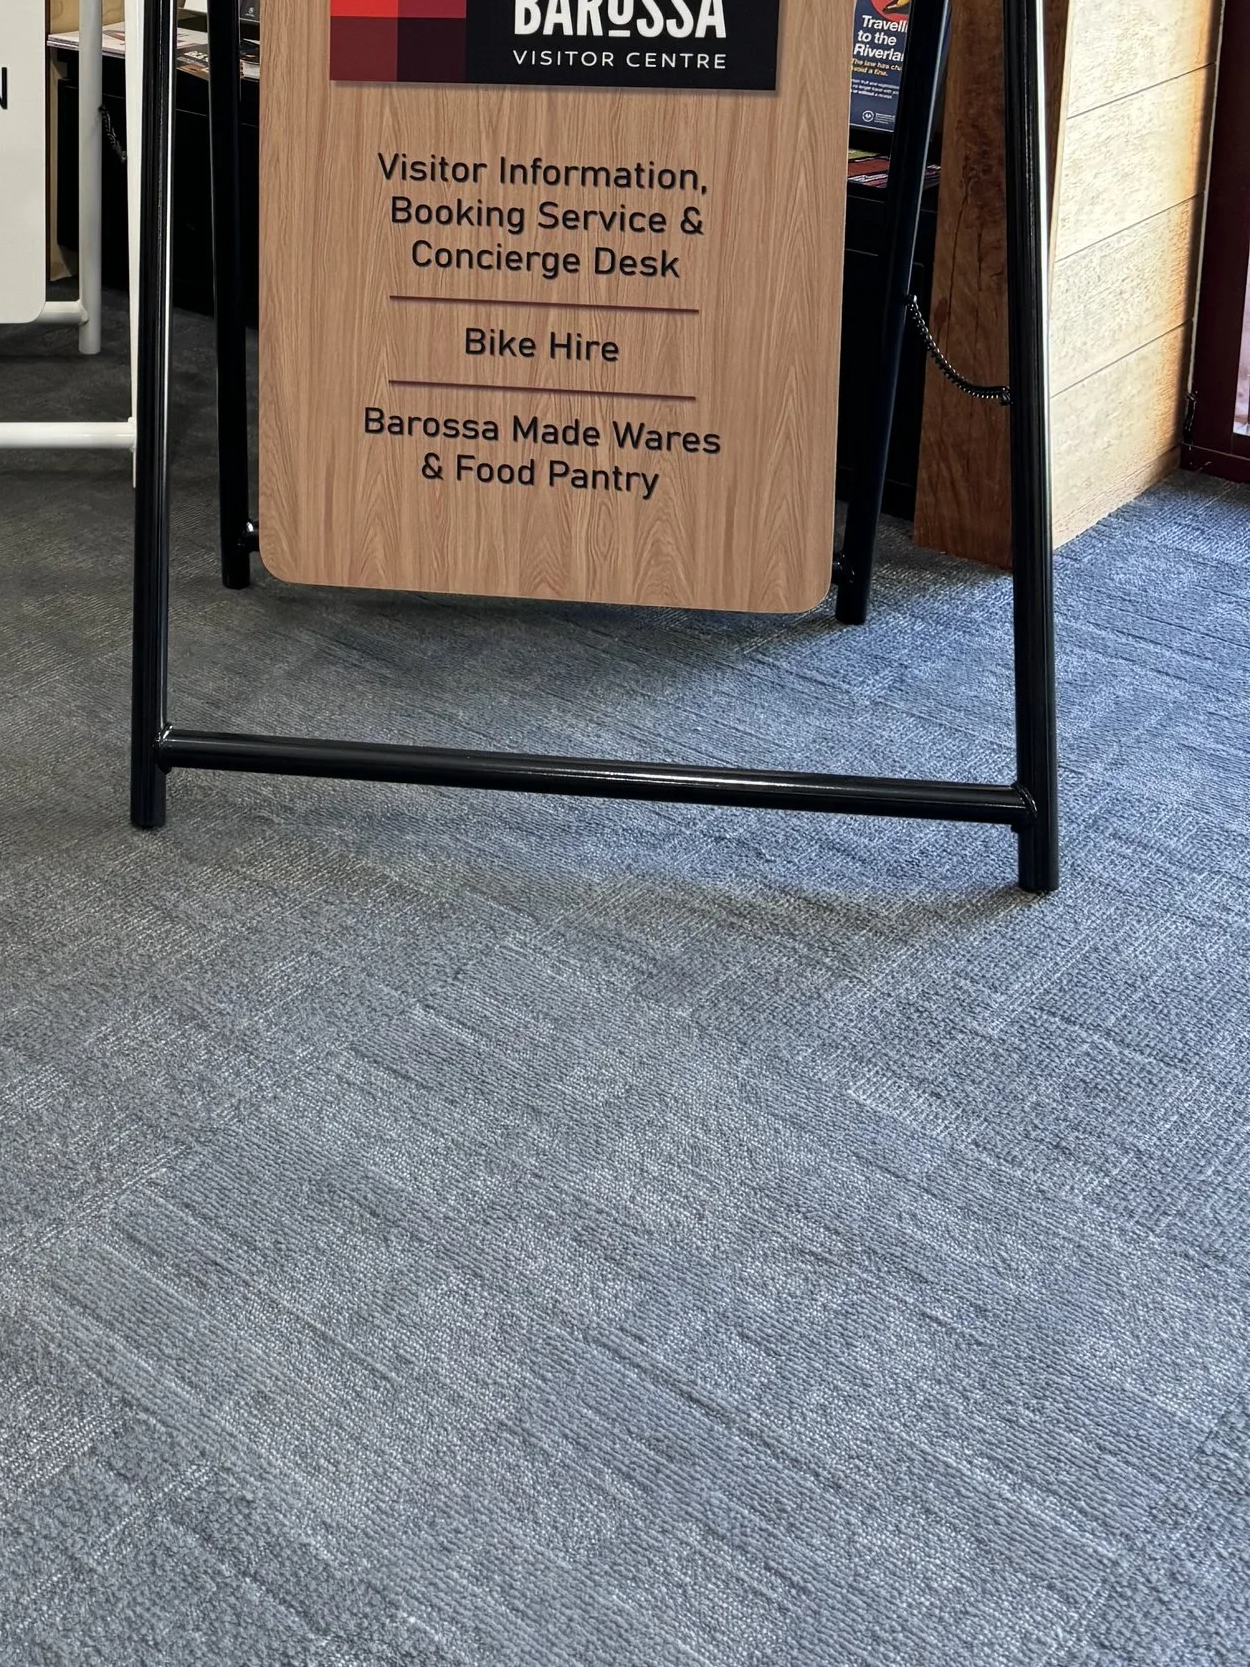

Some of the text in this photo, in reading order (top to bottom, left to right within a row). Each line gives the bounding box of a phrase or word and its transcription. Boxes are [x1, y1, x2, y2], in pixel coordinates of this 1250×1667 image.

[857, 30, 897, 46] to the
[512, 49, 727, 70] VISITOR CENTRE
[377, 151, 709, 196] Visitor Information,
[391, 195, 706, 236] Booking Service &
[411, 239, 681, 280] Concierge Desk
[464, 327, 621, 363] Bike Hire
[364, 406, 723, 455] Barossa Made Wares
[421, 453, 661, 500] & Food Pantry
